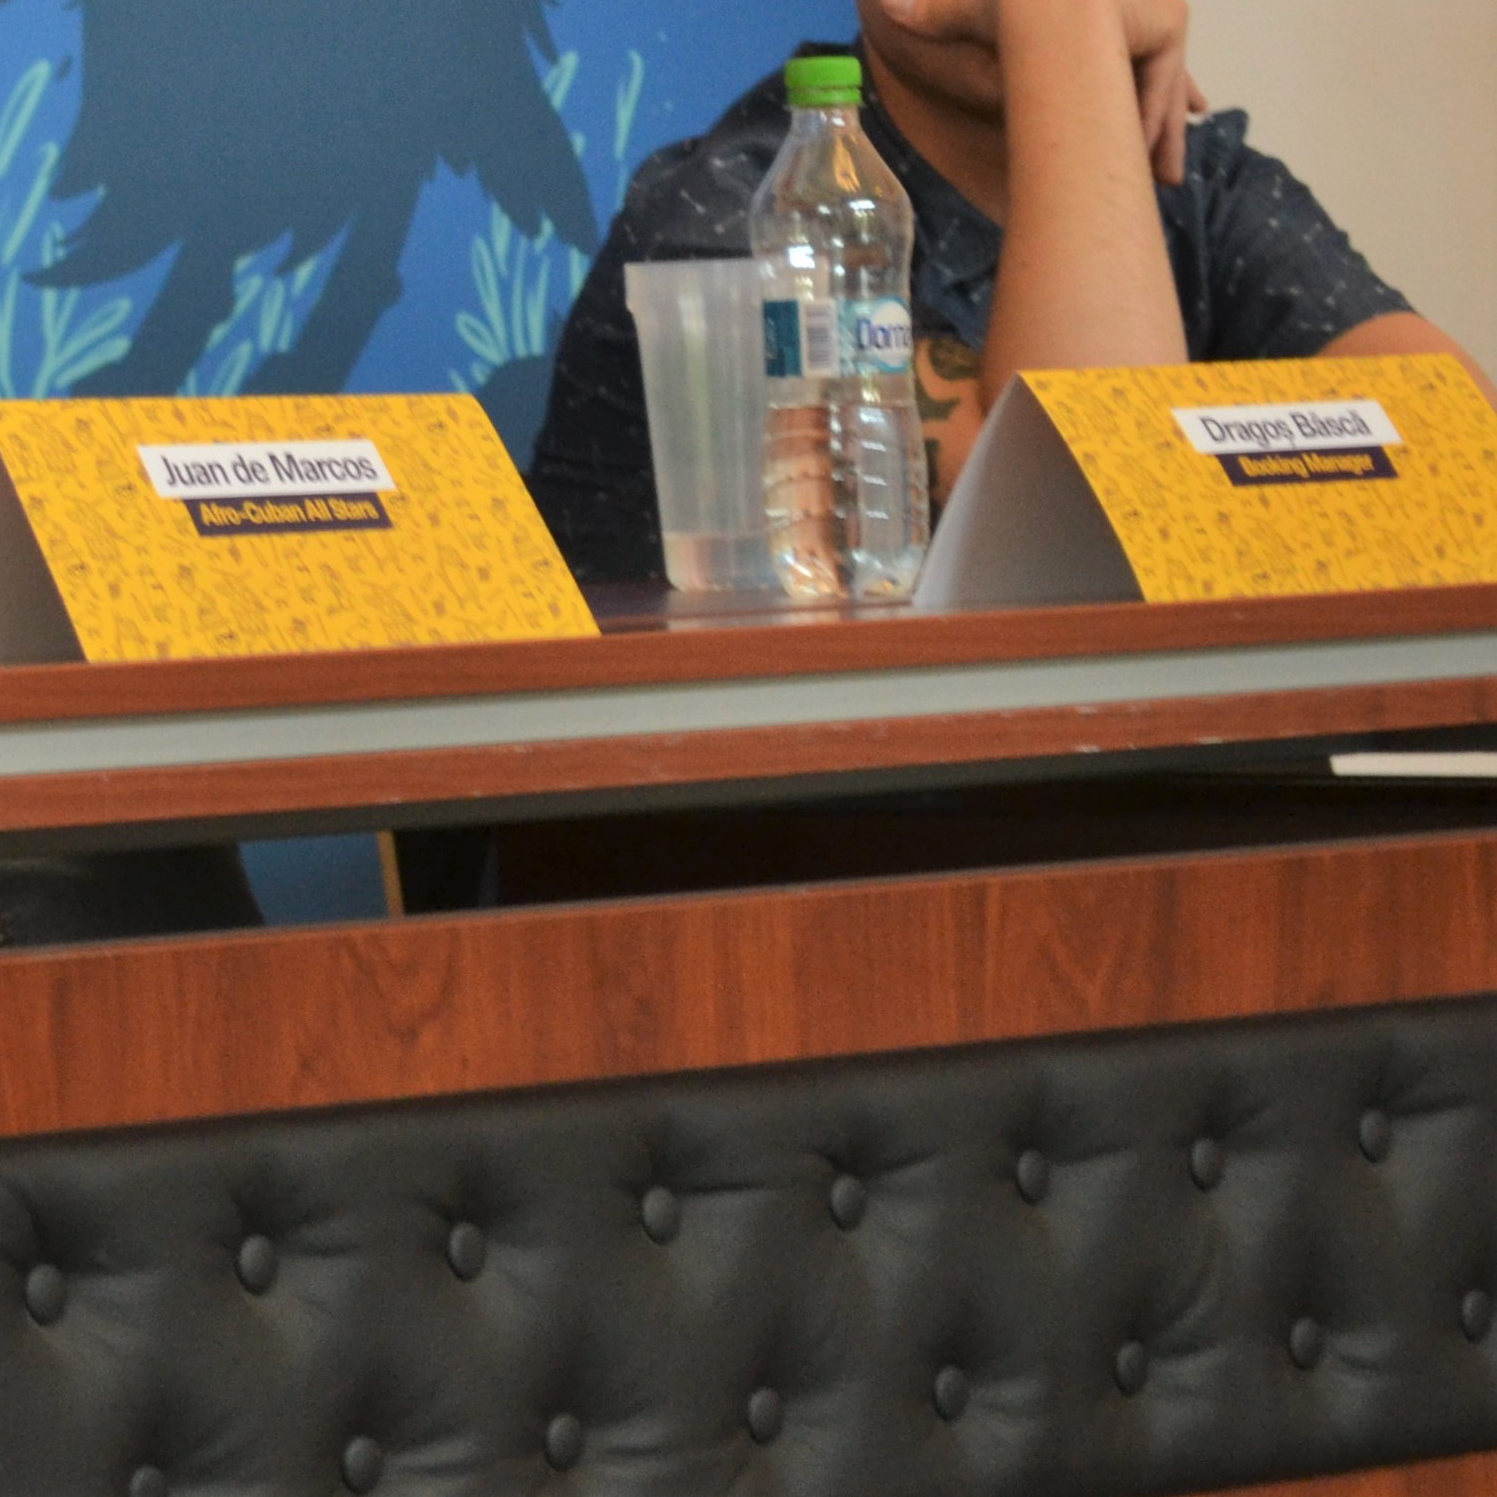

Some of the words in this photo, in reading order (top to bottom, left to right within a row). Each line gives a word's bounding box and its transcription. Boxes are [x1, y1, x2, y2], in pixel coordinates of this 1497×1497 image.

[160, 454, 232, 488] Juan
[233, 453, 270, 484] de
[268, 451, 379, 483] Marcos
[331, 497, 381, 521] Stars
